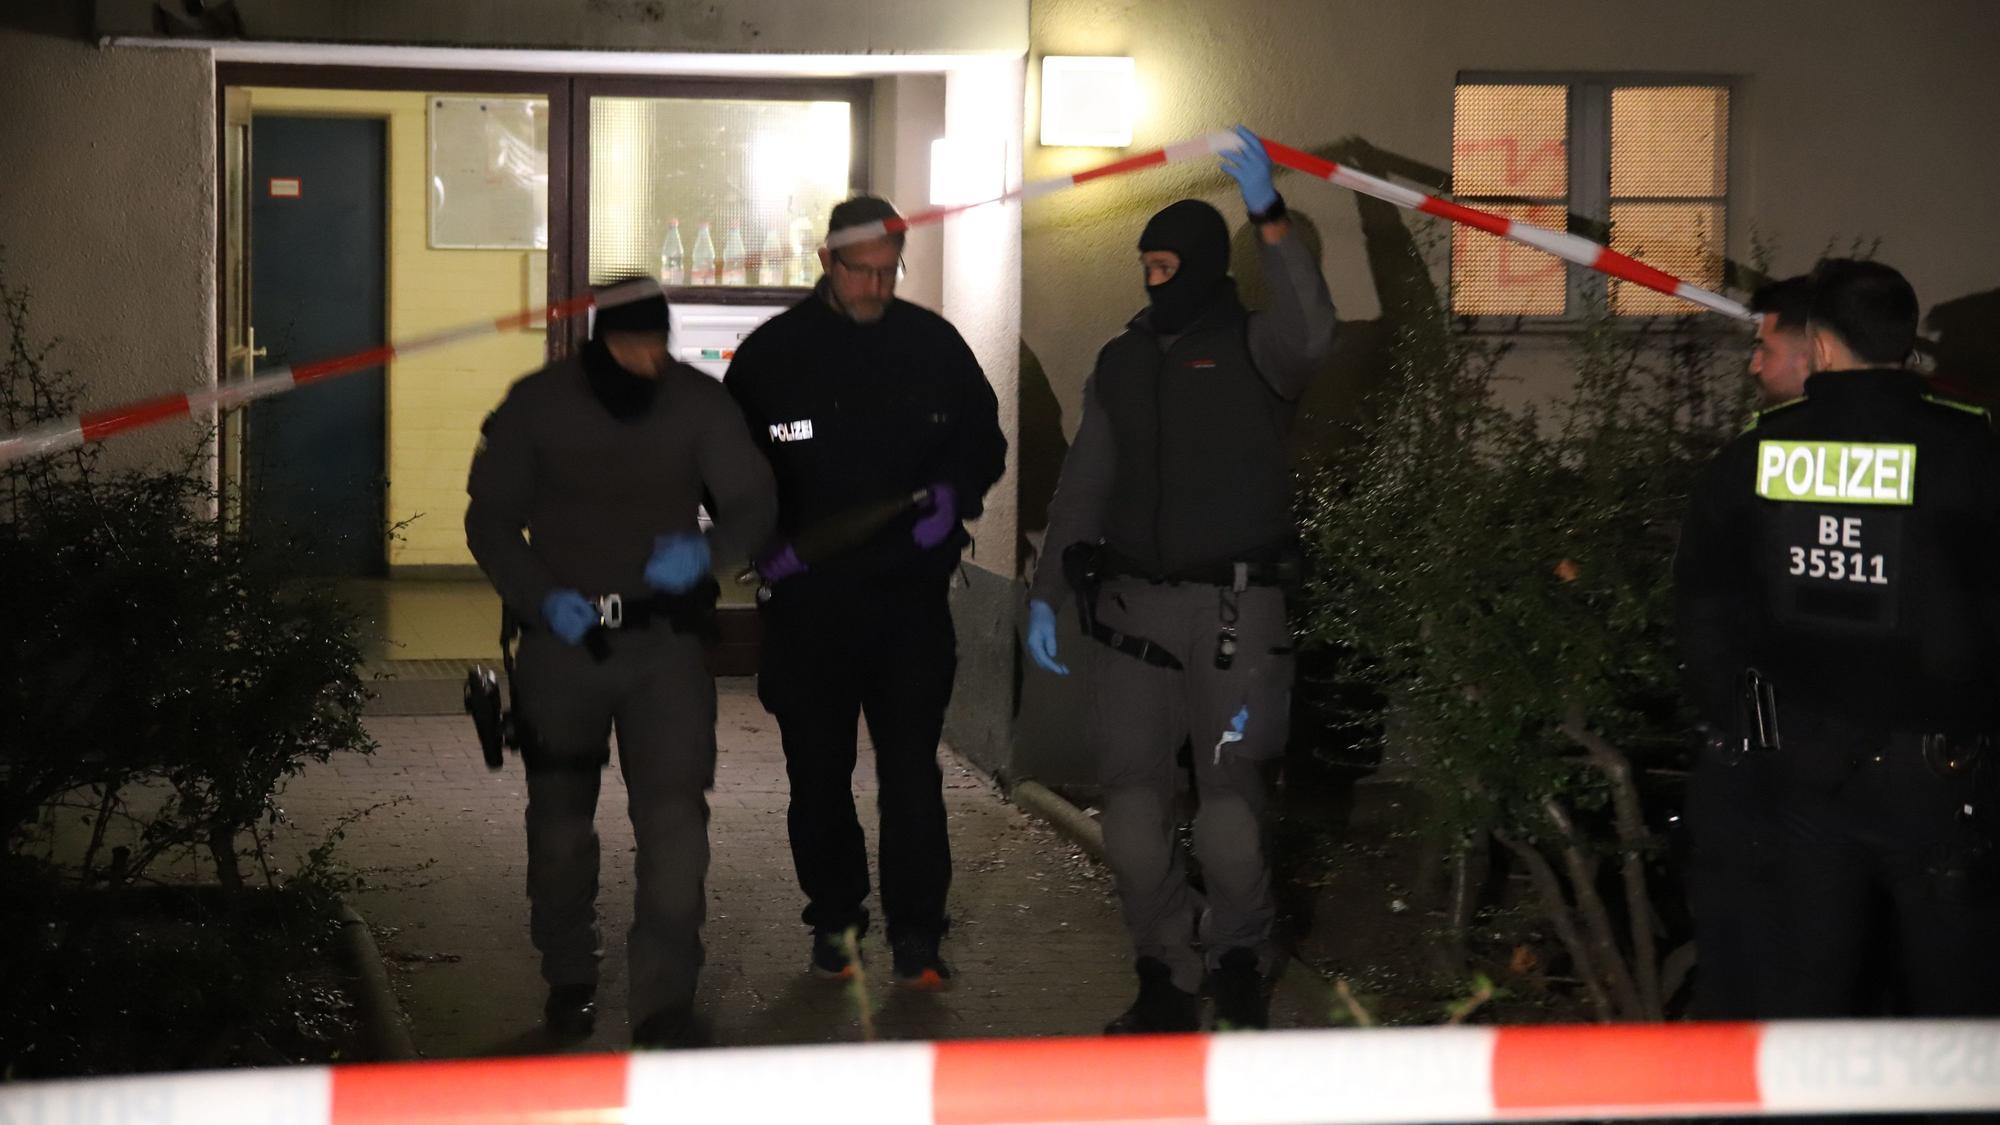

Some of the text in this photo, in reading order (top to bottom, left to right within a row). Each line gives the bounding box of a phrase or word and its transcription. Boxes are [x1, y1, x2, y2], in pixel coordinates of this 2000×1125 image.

[769, 419, 813, 442] POLIZEI
[1760, 445, 1911, 500] POLIZEI
[1818, 515, 1862, 548] BE
[1789, 546, 1888, 584] 35311
